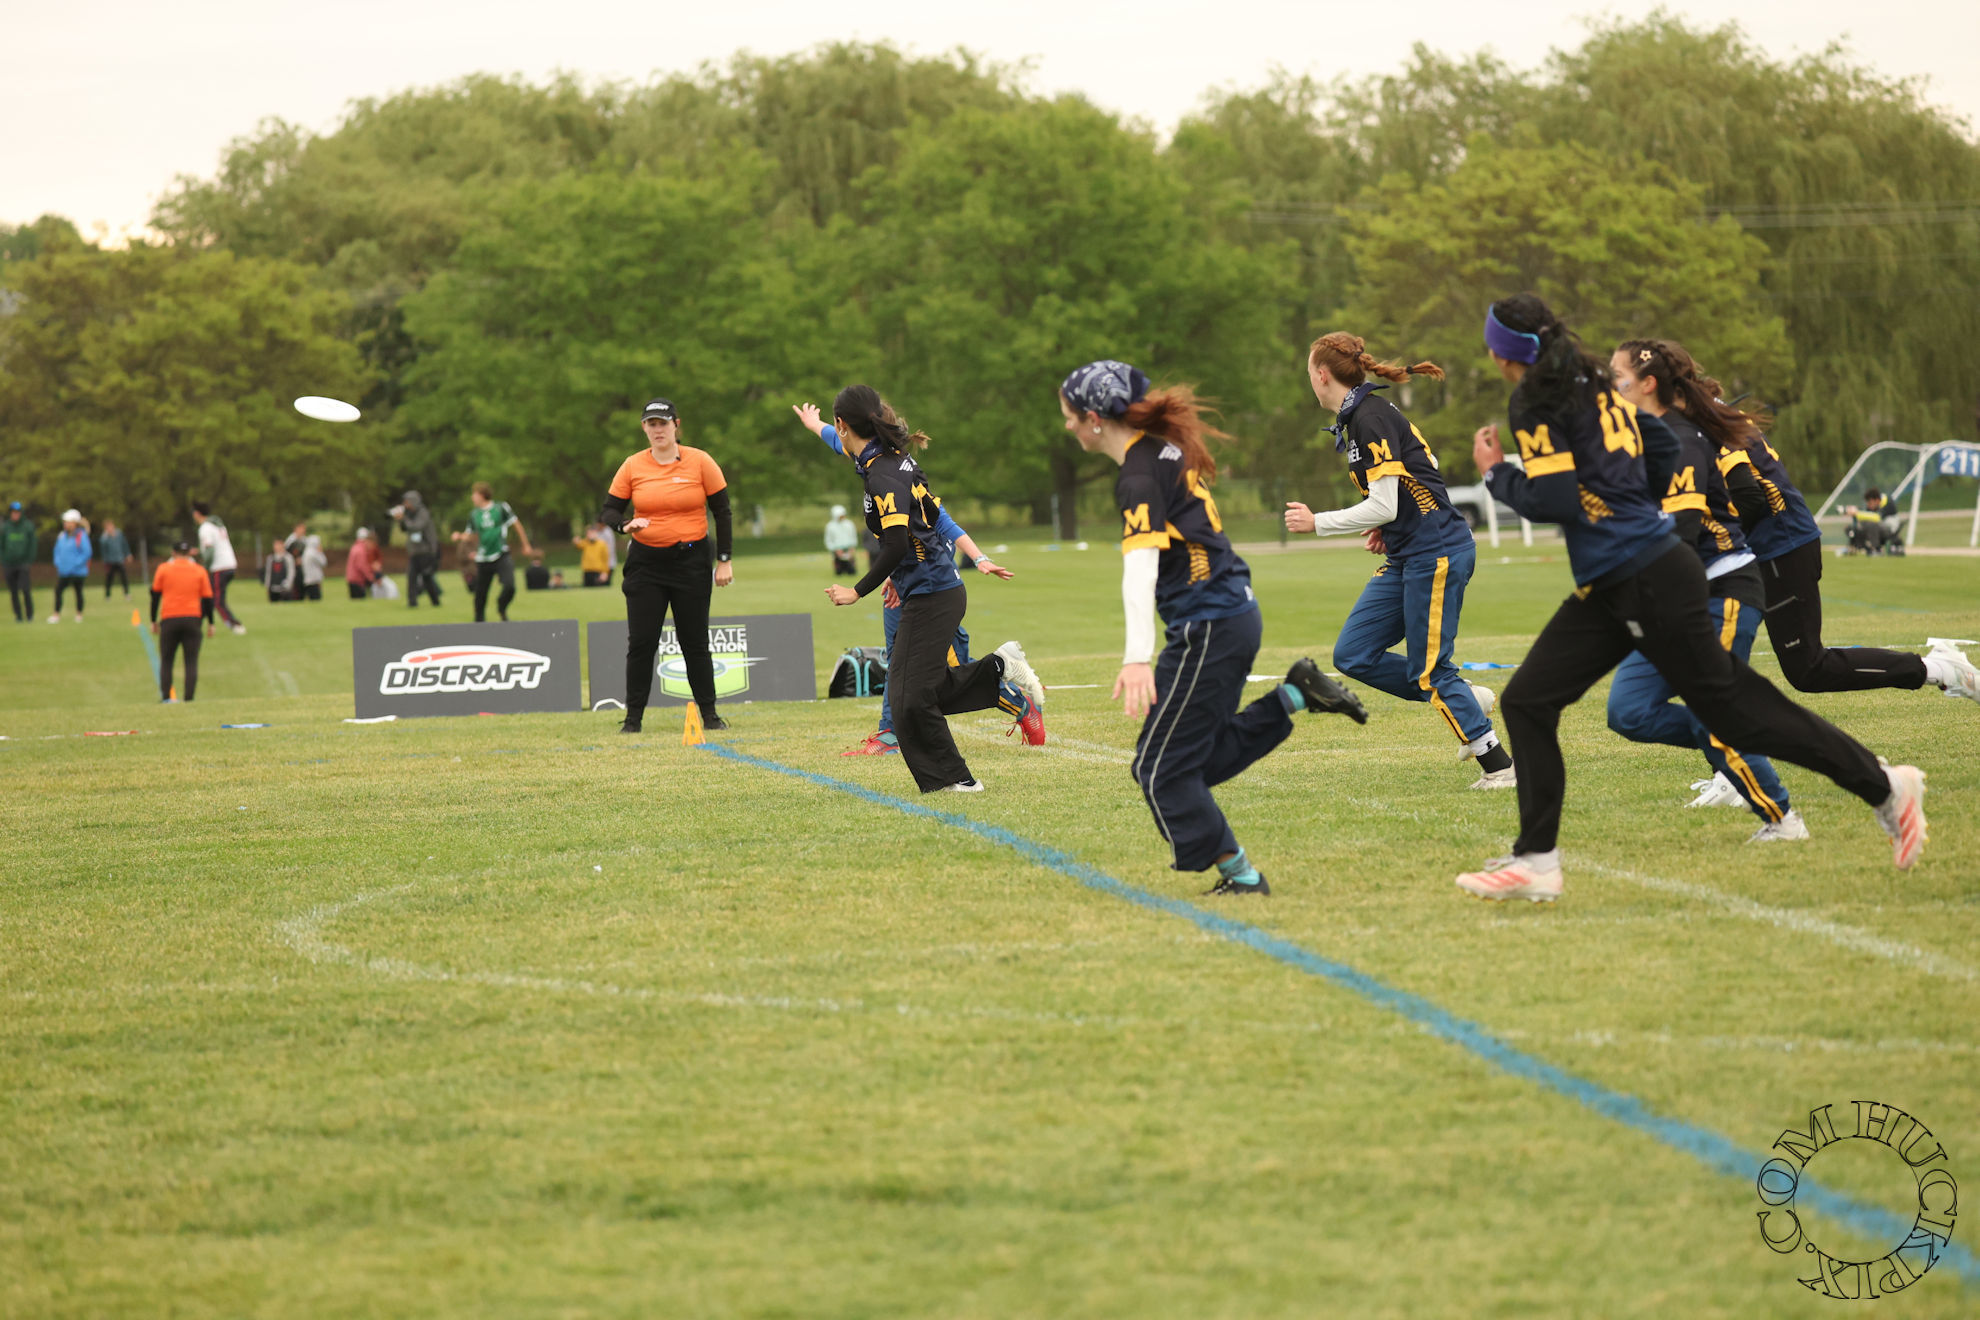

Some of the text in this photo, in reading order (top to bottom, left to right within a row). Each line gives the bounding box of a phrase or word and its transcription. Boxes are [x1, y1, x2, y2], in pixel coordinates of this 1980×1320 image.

[1367, 438, 1393, 465] M
[1515, 424, 1555, 460] M
[1940, 446, 1980, 477] 211
[1666, 465, 1697, 496] M
[873, 492, 898, 517] M
[1123, 503, 1152, 537] M
[386, 662, 544, 688] DISCRAFT
